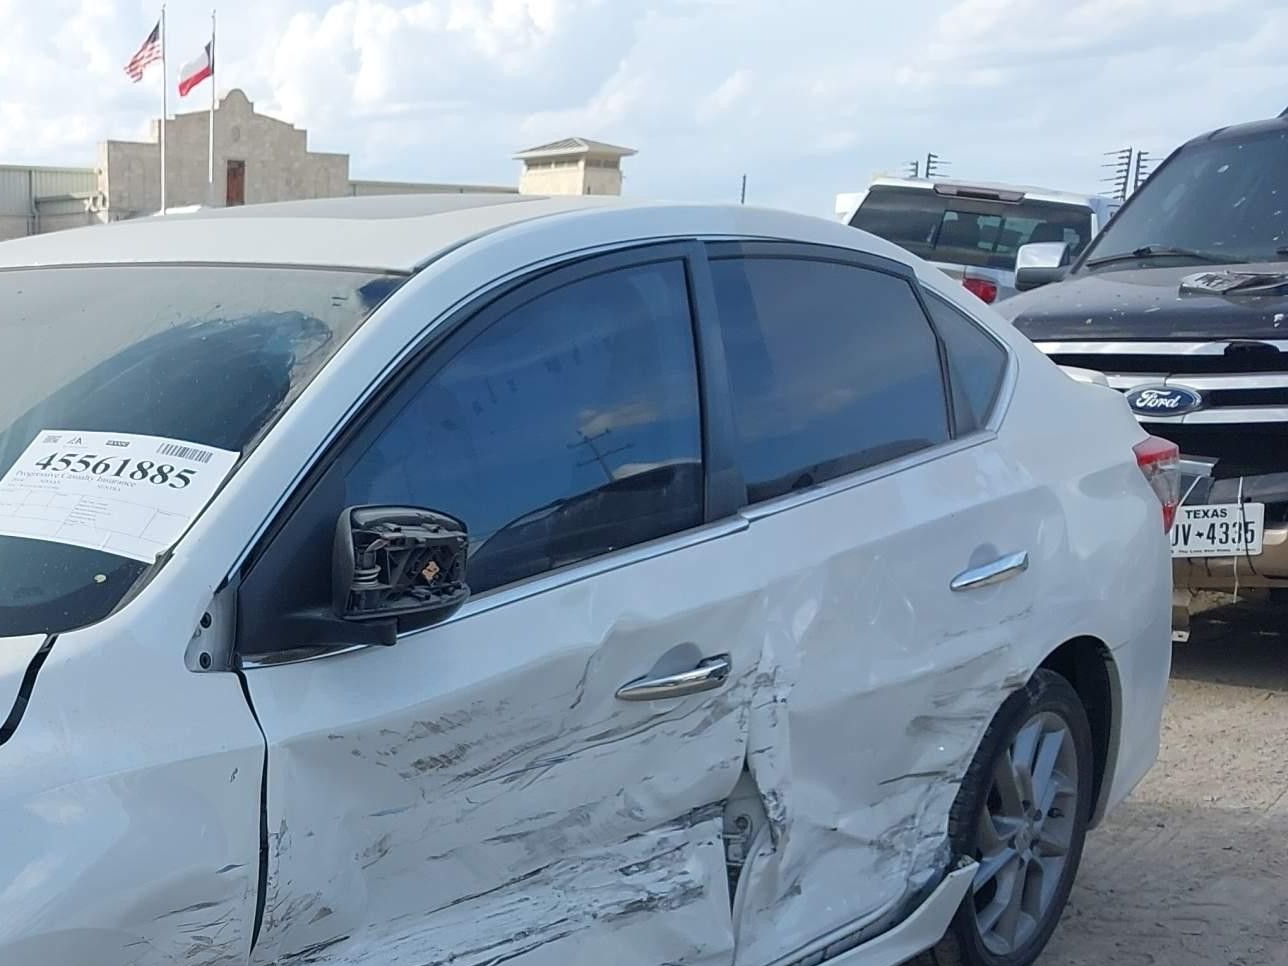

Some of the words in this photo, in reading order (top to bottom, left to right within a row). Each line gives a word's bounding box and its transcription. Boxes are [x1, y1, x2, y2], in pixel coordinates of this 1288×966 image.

[1135, 389, 1182, 408] Ford
[35, 452, 197, 489] 45561885
[1185, 507, 1228, 519] TEXAS
